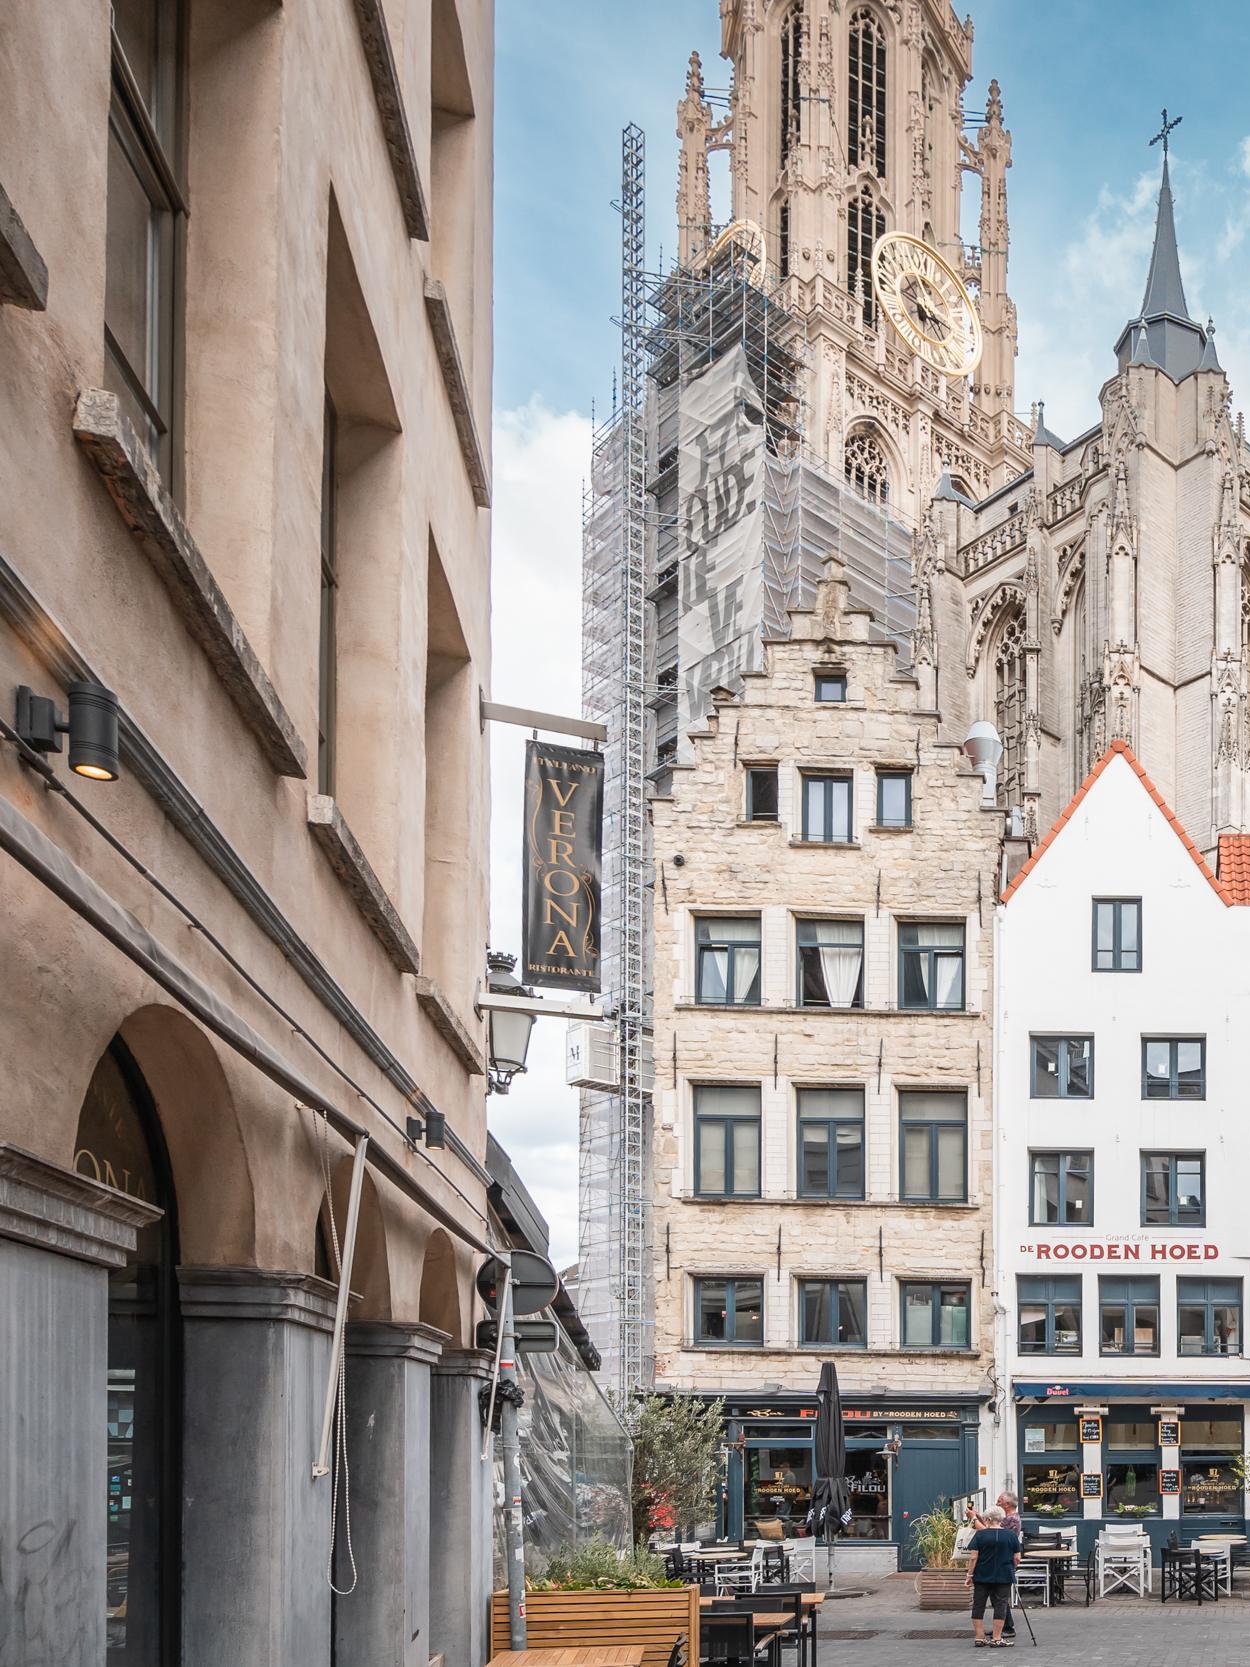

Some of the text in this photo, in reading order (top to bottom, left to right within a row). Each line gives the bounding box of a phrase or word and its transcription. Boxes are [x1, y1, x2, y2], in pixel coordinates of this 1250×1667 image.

[685, 448, 756, 550] OUDE
[544, 779, 581, 957] VERONA
[1105, 1233, 1130, 1242] Grand
[1020, 1243, 1219, 1260] DE ROODEN HOED
[800, 1409, 871, 1418] FIOU
[851, 1484, 886, 1493] FILOU
